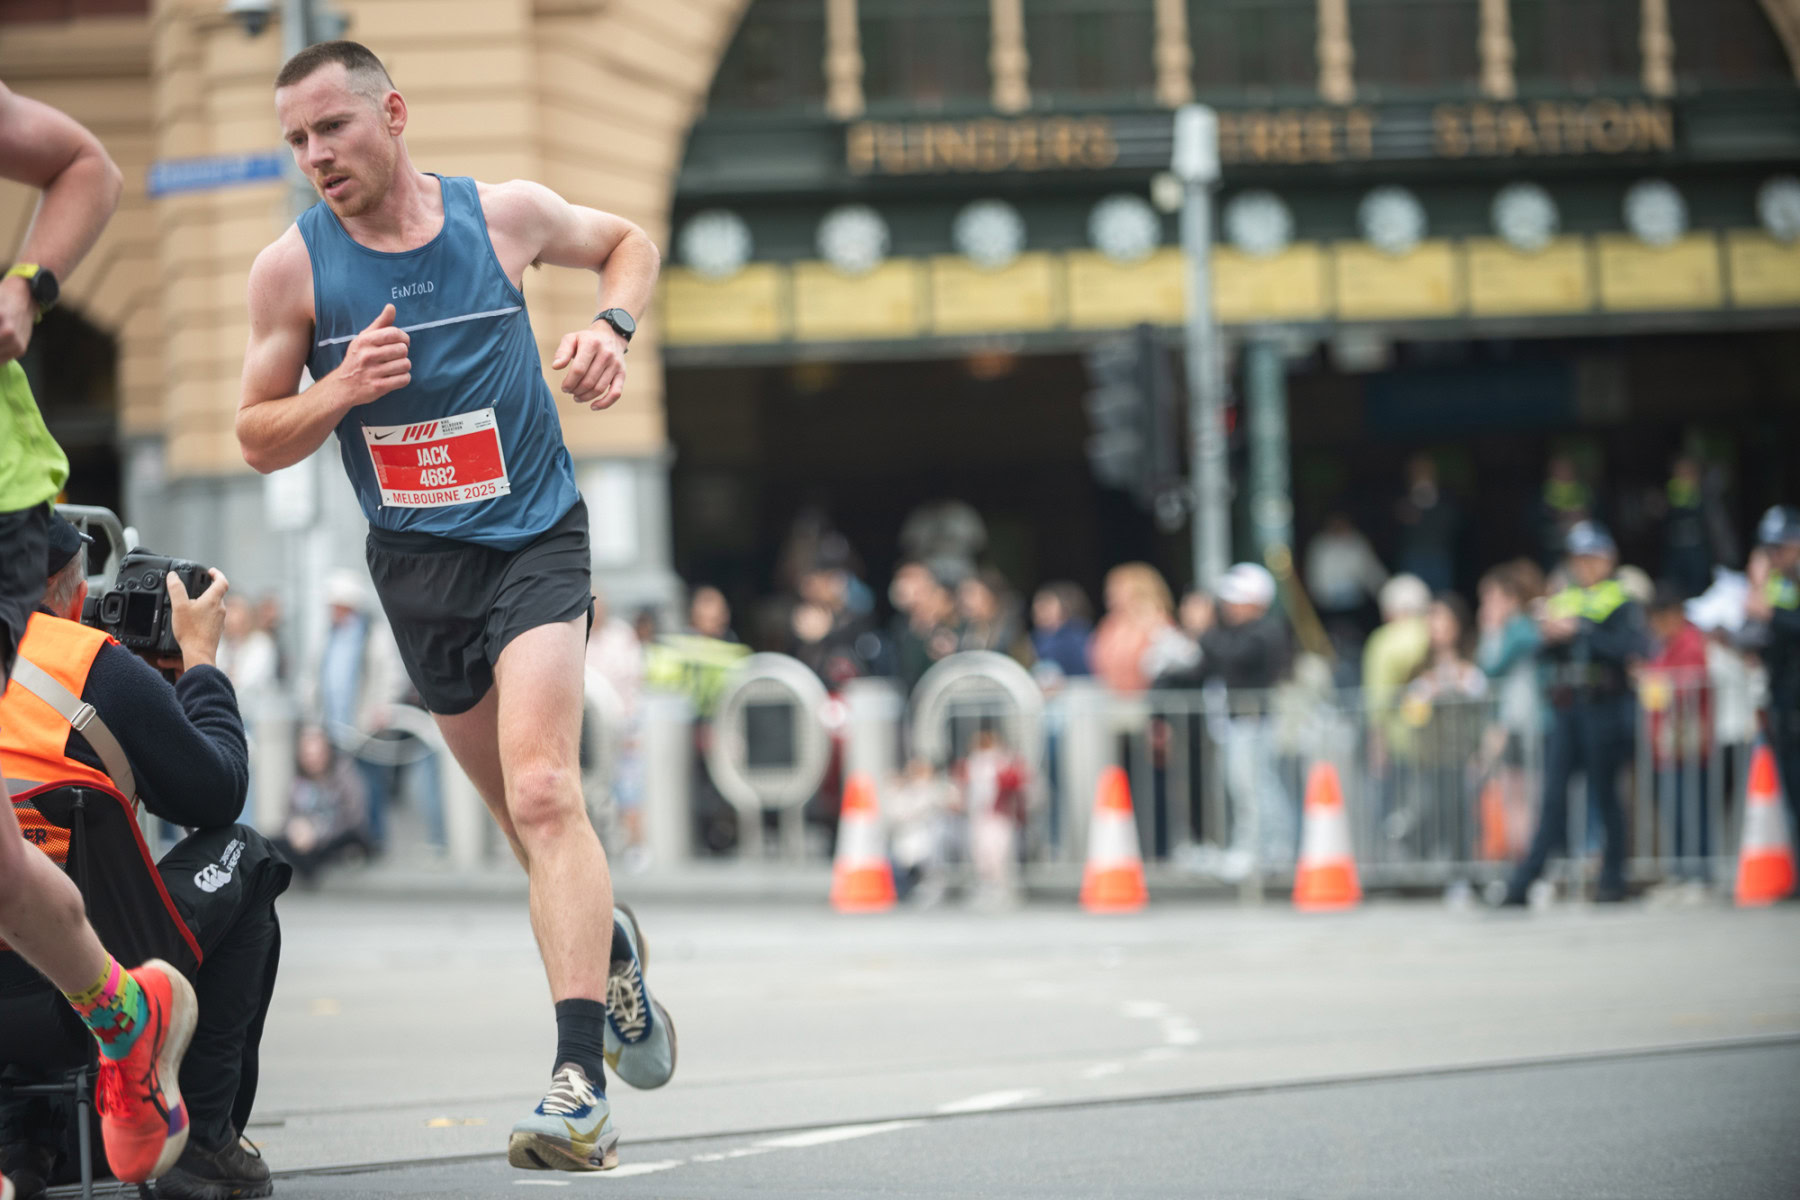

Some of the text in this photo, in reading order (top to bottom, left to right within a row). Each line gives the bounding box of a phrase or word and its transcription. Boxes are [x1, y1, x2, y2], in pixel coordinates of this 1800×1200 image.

[1219, 109, 1374, 164] TREET
[416, 444, 452, 467] JACK
[419, 466, 458, 488] 4682
[392, 482, 496, 505] MELBOURNE 2025
